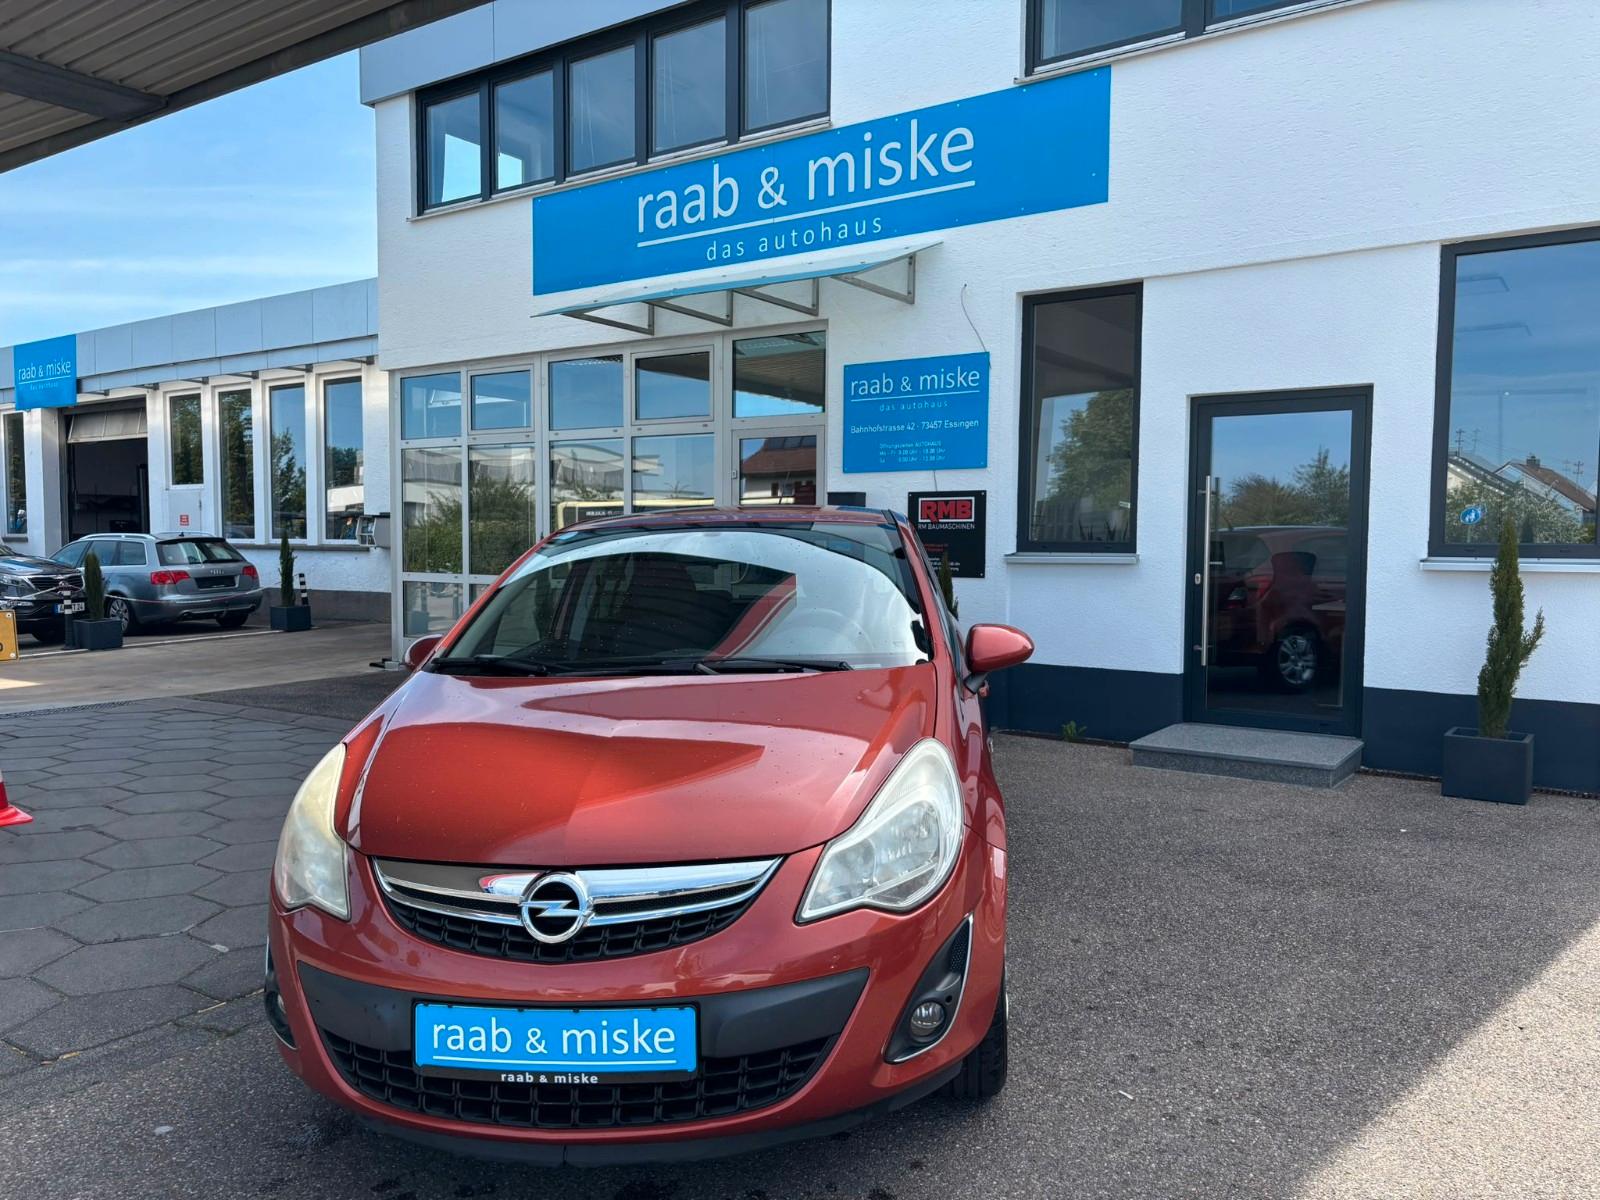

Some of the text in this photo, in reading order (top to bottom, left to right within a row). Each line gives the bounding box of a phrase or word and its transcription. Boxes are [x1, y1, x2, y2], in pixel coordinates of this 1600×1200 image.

[636, 118, 976, 234] raab & miske
[706, 216, 883, 262] das autohaus
[18, 357, 71, 381] raab & miske
[851, 365, 980, 396] raab & miske
[880, 400, 949, 412] das autohaus
[850, 424, 905, 433] Bahnhofstrasse
[906, 421, 916, 431] 42
[921, 420, 943, 431] 73457
[944, 419, 979, 430] Essingen
[921, 501, 972, 523] RMB
[433, 1016, 676, 1055] raab & miske
[500, 1072, 599, 1084] raab & miske
